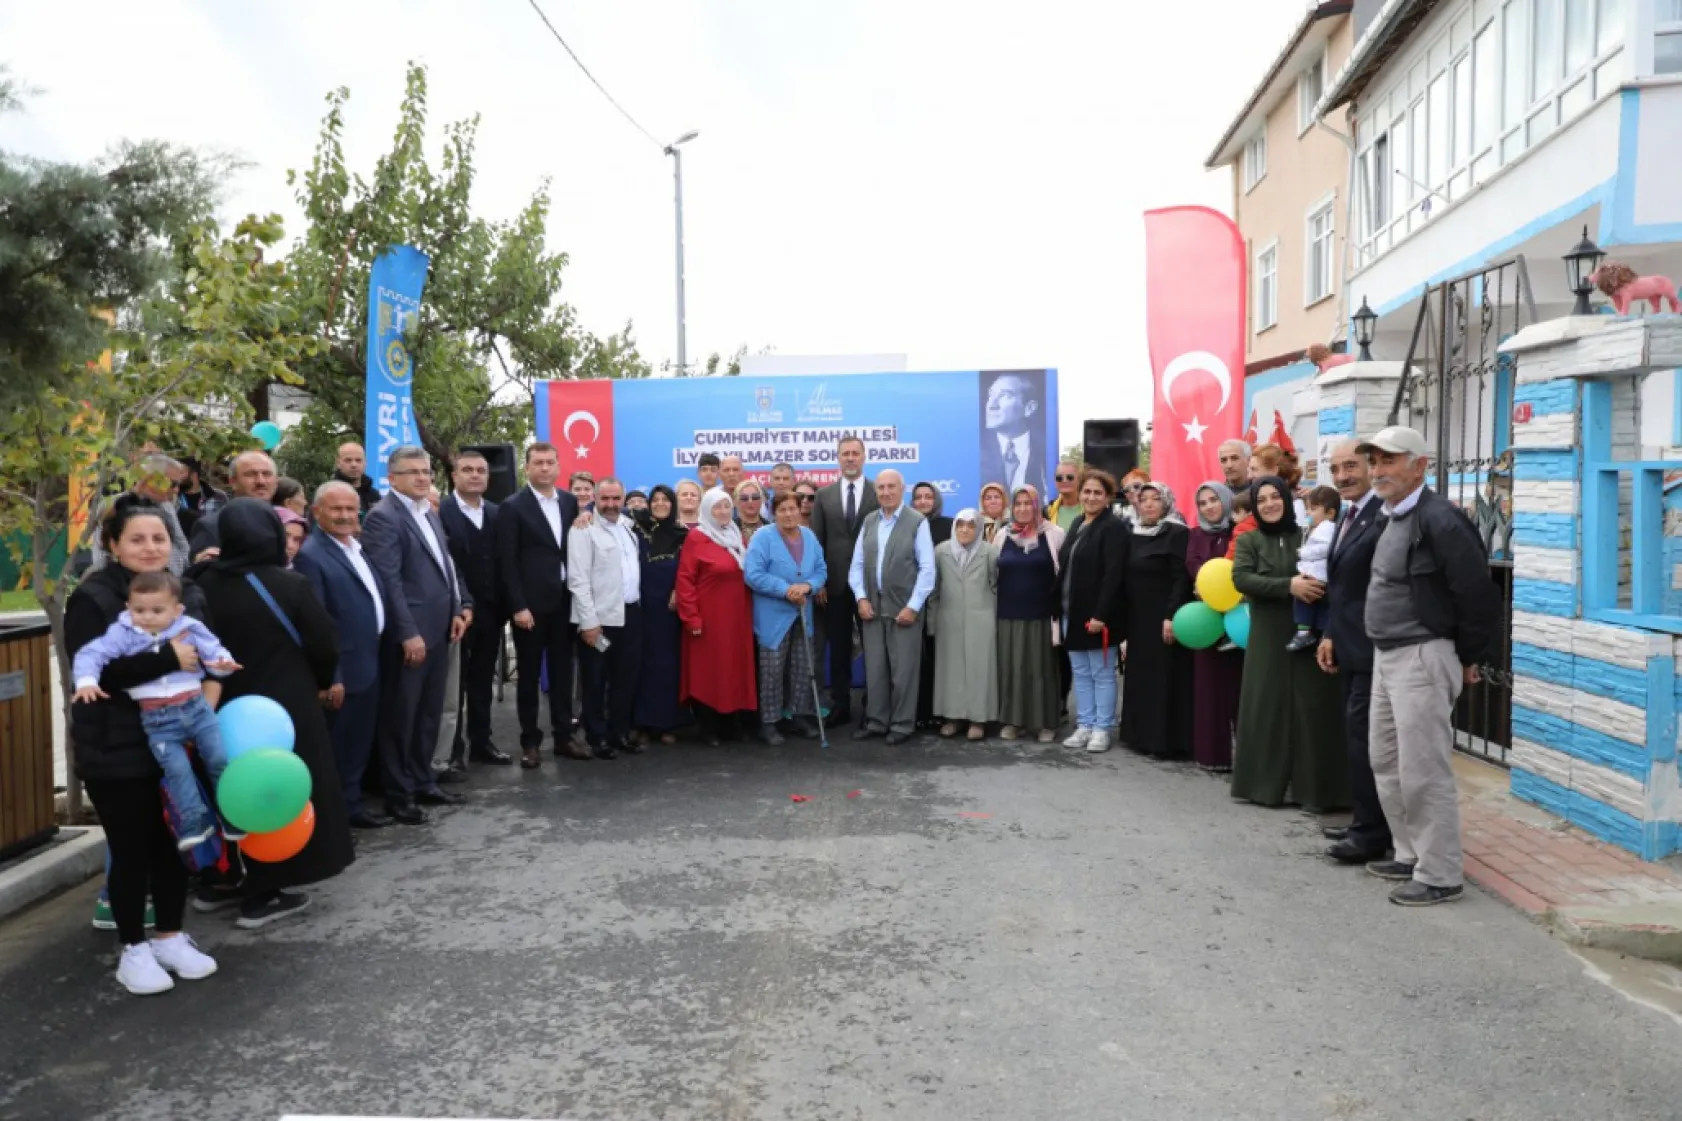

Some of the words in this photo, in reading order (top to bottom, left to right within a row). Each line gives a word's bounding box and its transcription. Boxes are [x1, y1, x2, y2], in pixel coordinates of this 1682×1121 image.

[694, 428, 800, 445] CUMHURİYET
[676, 449, 720, 465] İLY
[868, 447, 916, 461] PARKI
